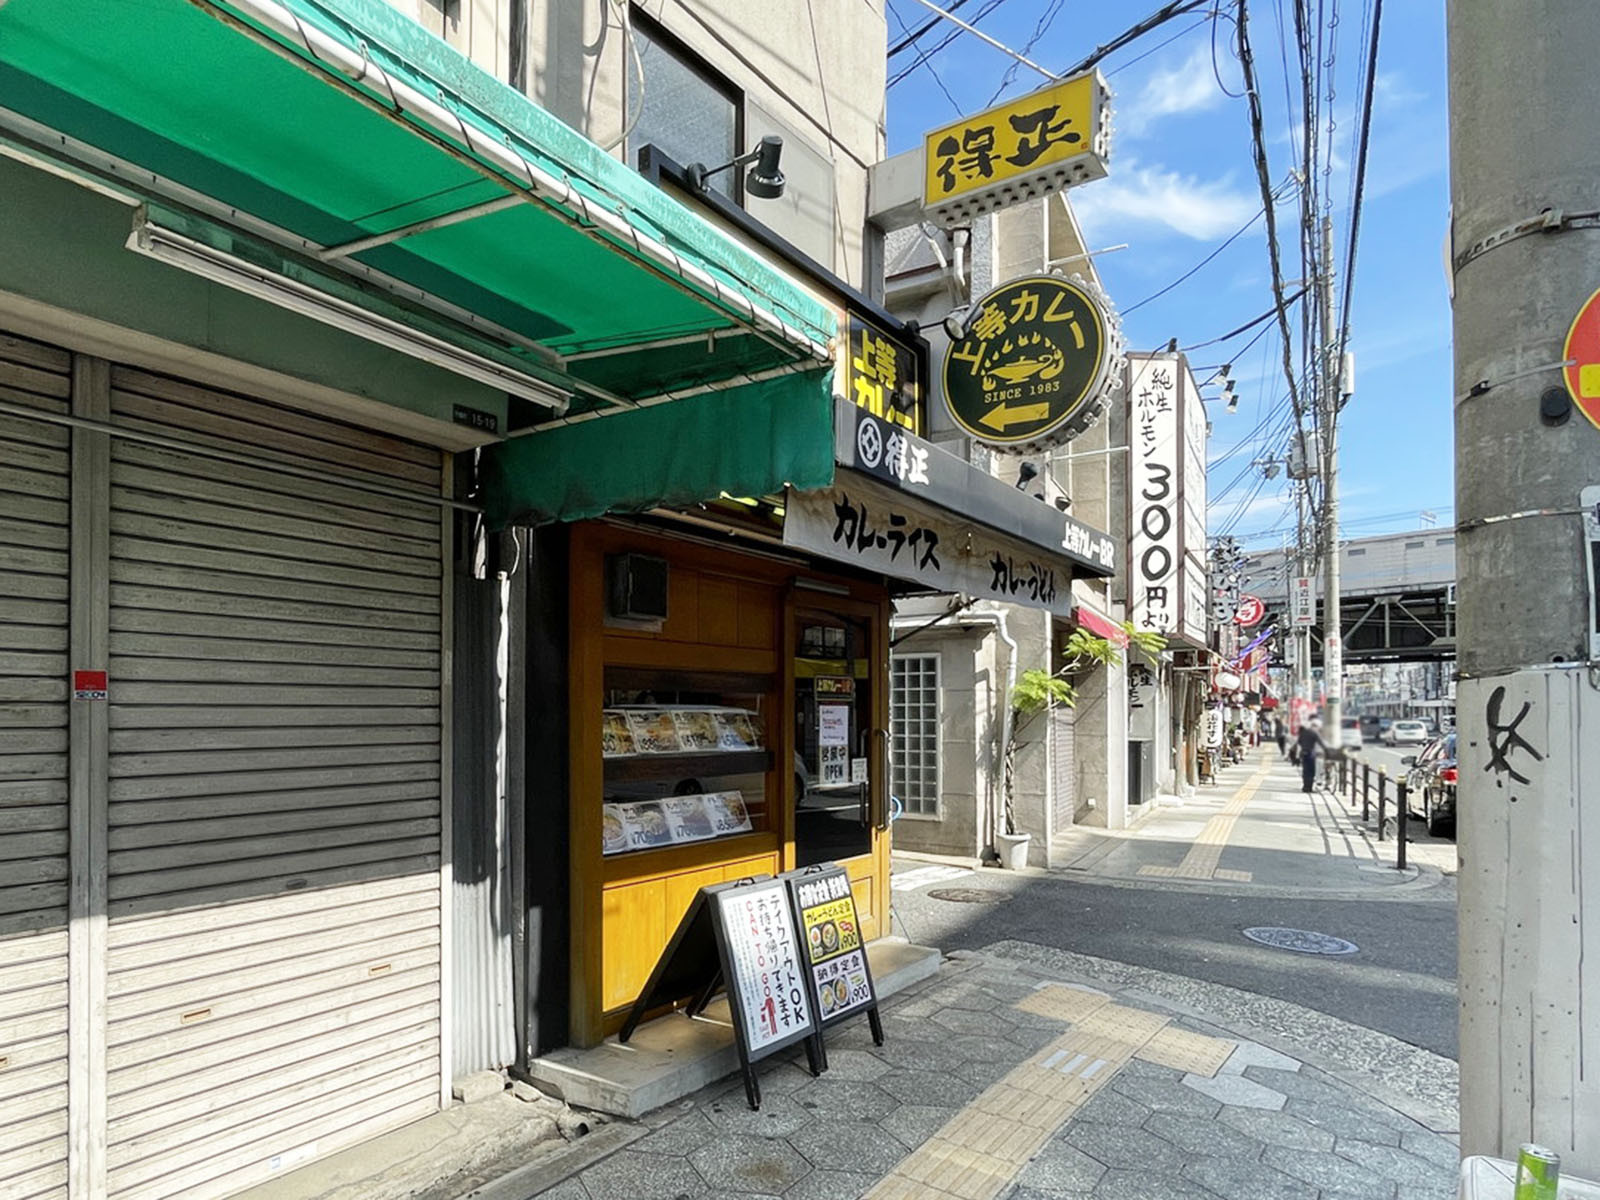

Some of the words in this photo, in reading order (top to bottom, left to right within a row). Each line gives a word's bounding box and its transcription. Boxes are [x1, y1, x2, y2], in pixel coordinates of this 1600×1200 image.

[936, 105, 1081, 192] 得正
[853, 329, 897, 390] 上等
[953, 289, 1085, 375] 上等カレー
[984, 388, 1021, 404] SINCE
[1030, 381, 1061, 398] 1983
[1138, 386, 1156, 458] ホルモン
[885, 432, 929, 485] 得正
[824, 764, 843, 781] OPEN
[746, 900, 759, 935] CAN
[755, 943, 765, 967] TO
[761, 973, 771, 997] GO
[757, 897, 792, 1028] お持ち帰りできます
[769, 894, 805, 1026] テイクアウトOK
